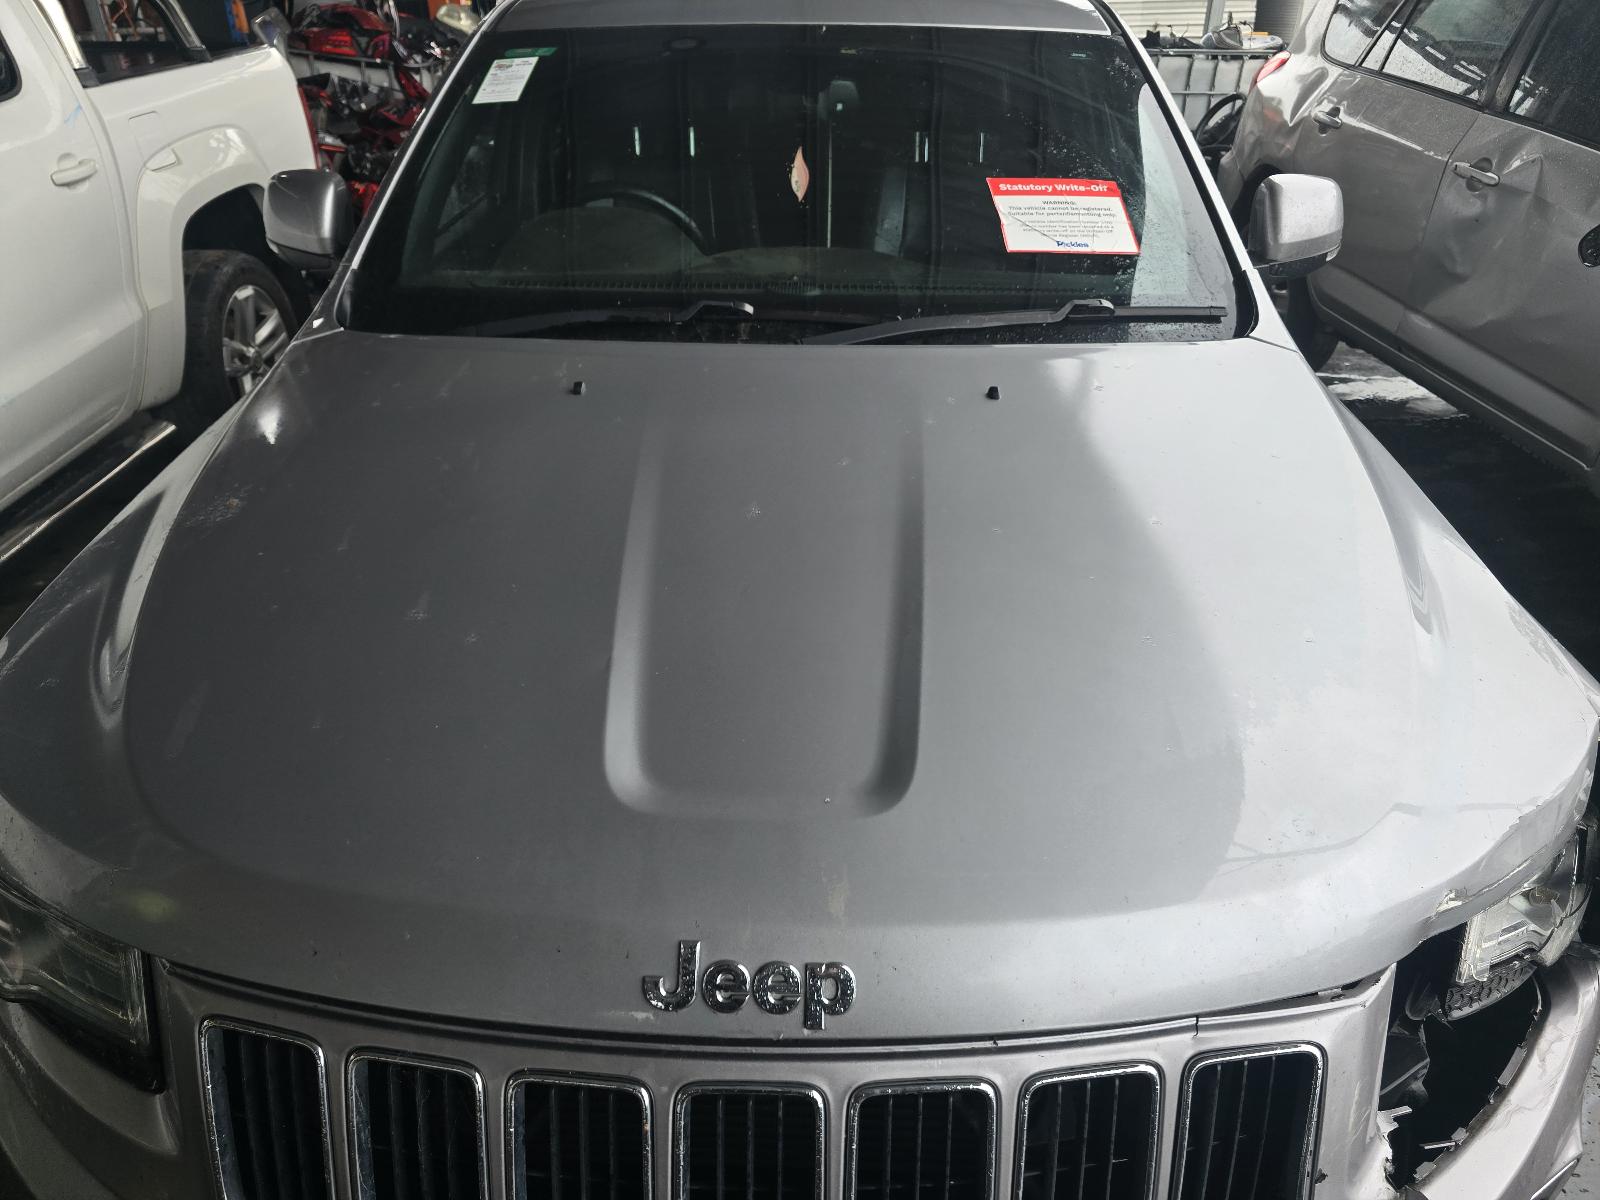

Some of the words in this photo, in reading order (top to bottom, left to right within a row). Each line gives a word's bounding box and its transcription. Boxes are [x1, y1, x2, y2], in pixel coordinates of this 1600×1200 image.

[998, 184, 1053, 192] Statutory
[1054, 184, 1108, 192] Write-Off
[642, 940, 857, 1030] Jeep
